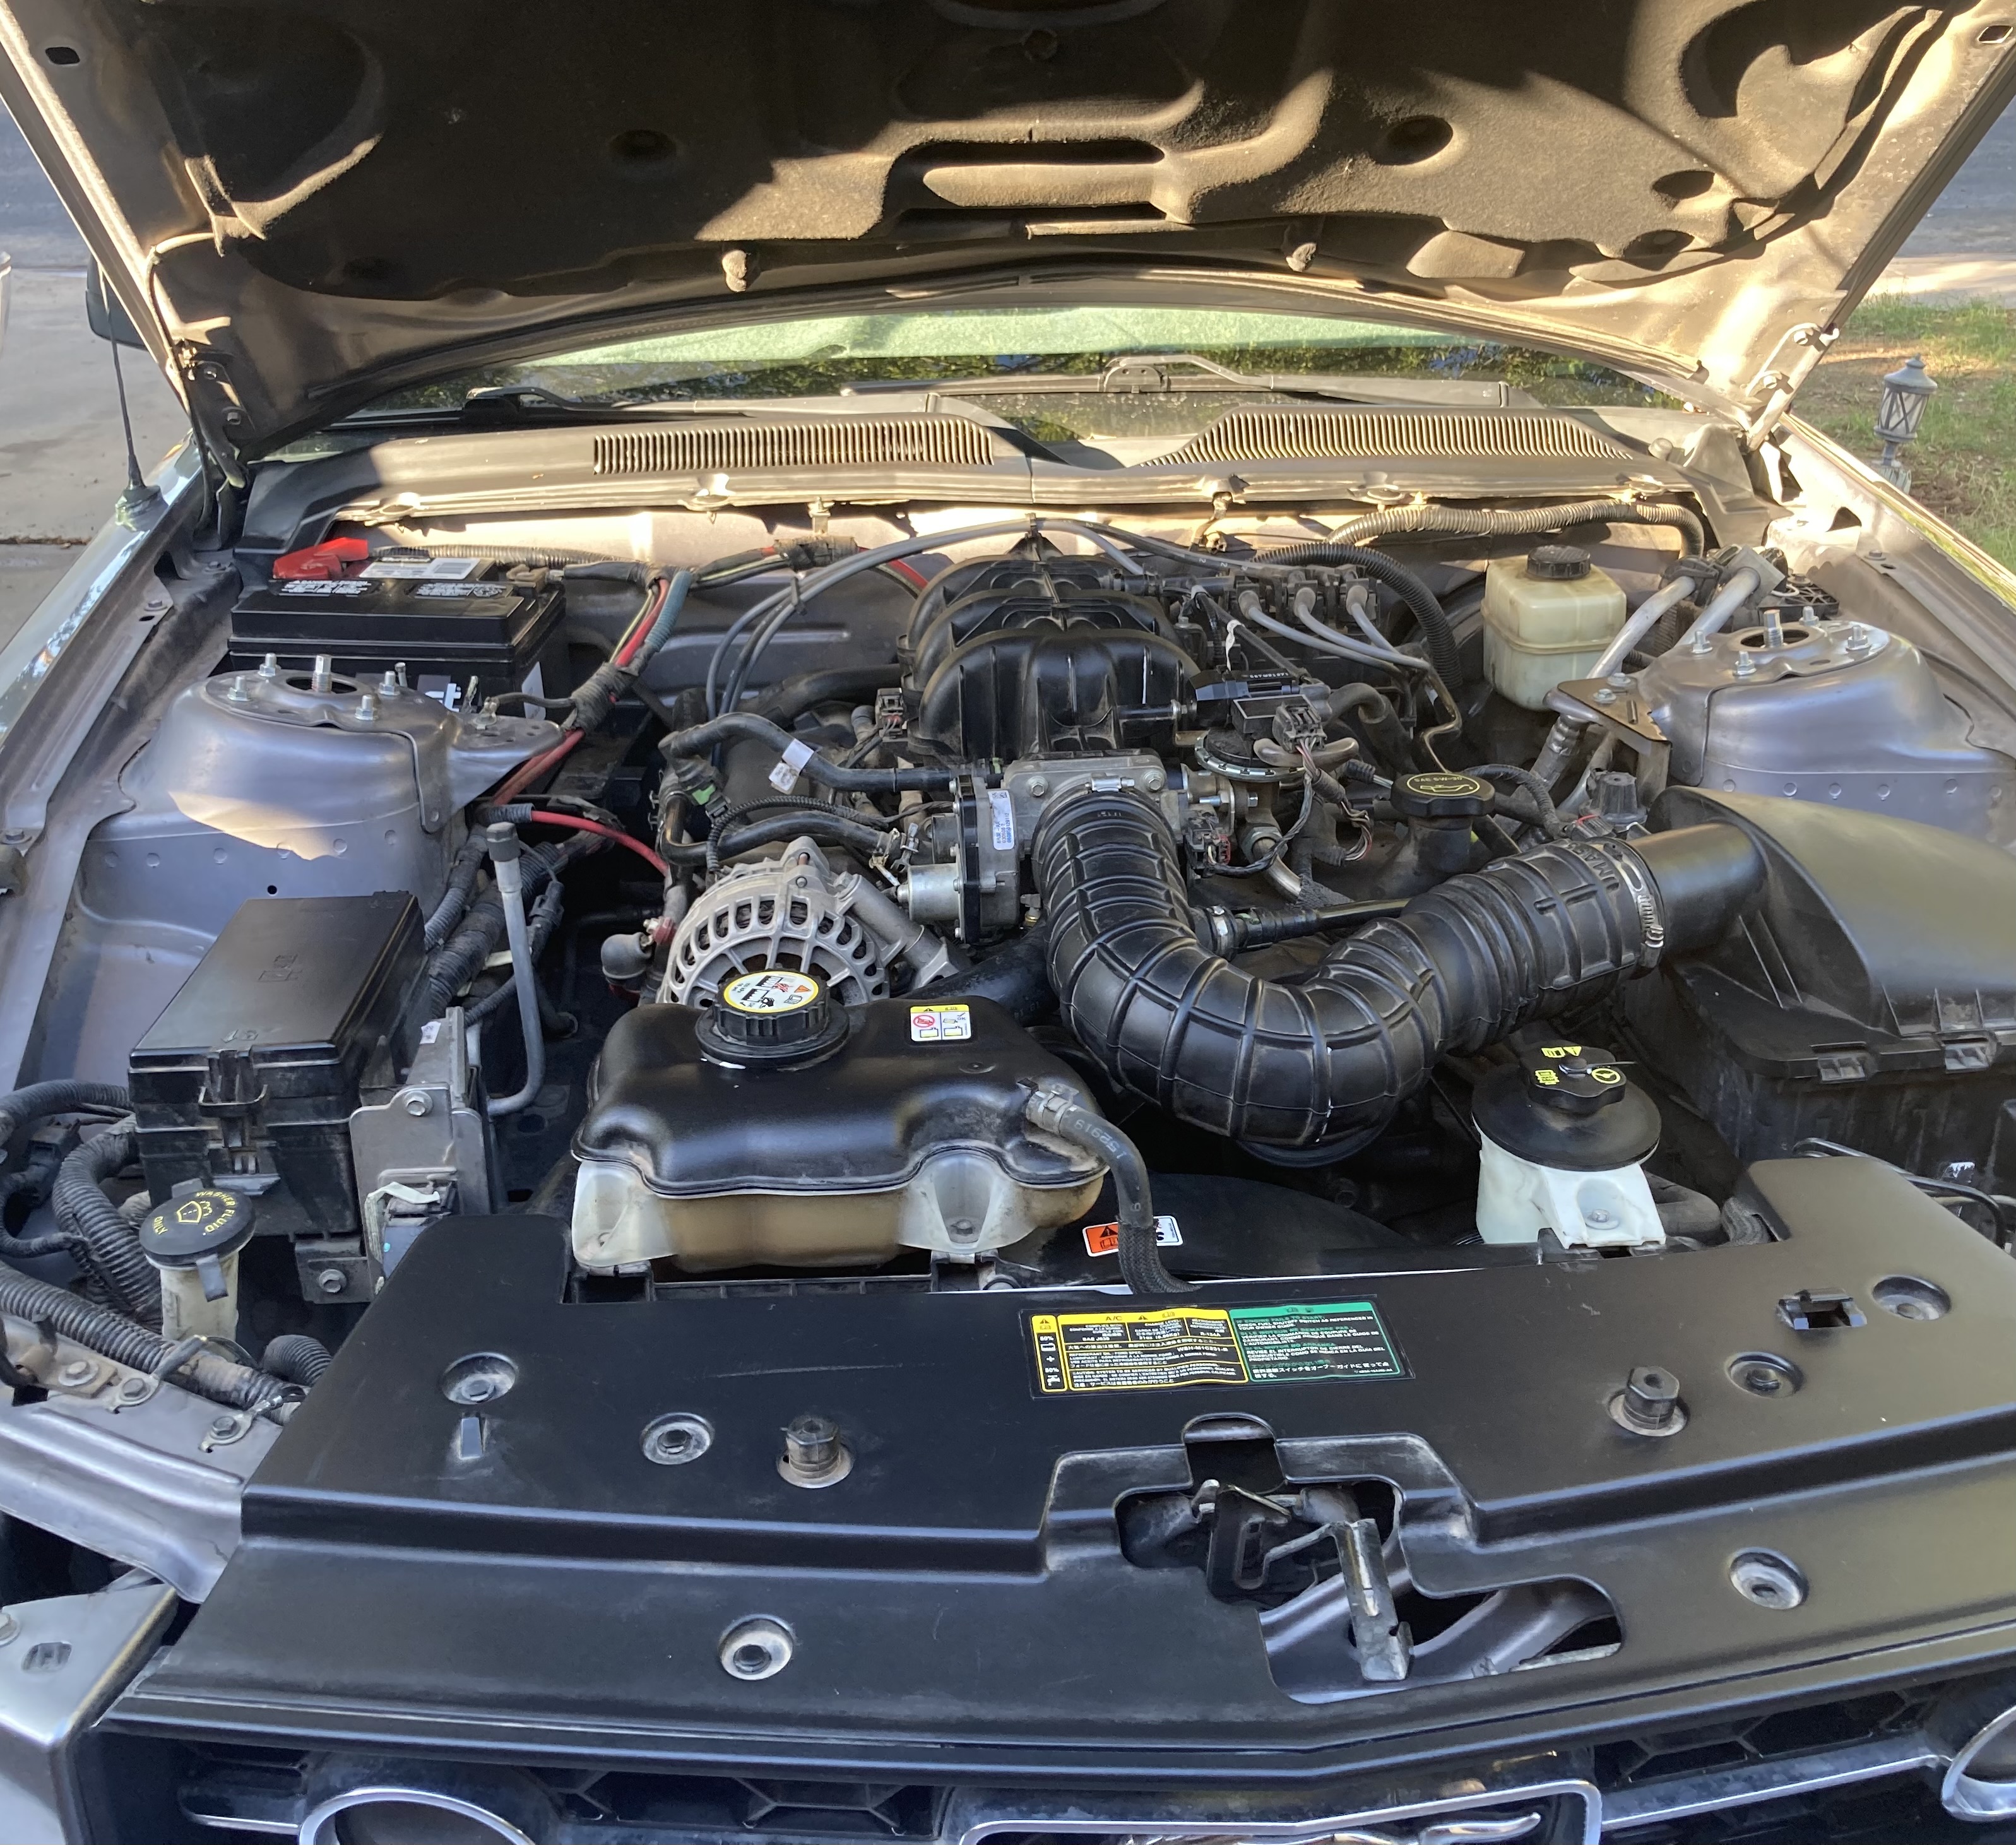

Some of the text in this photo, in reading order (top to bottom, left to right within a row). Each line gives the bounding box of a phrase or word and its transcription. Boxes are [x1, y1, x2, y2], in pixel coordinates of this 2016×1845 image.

[153, 1216, 169, 1235] ONLY
[195, 1191, 237, 1233] WASHER FLUID
